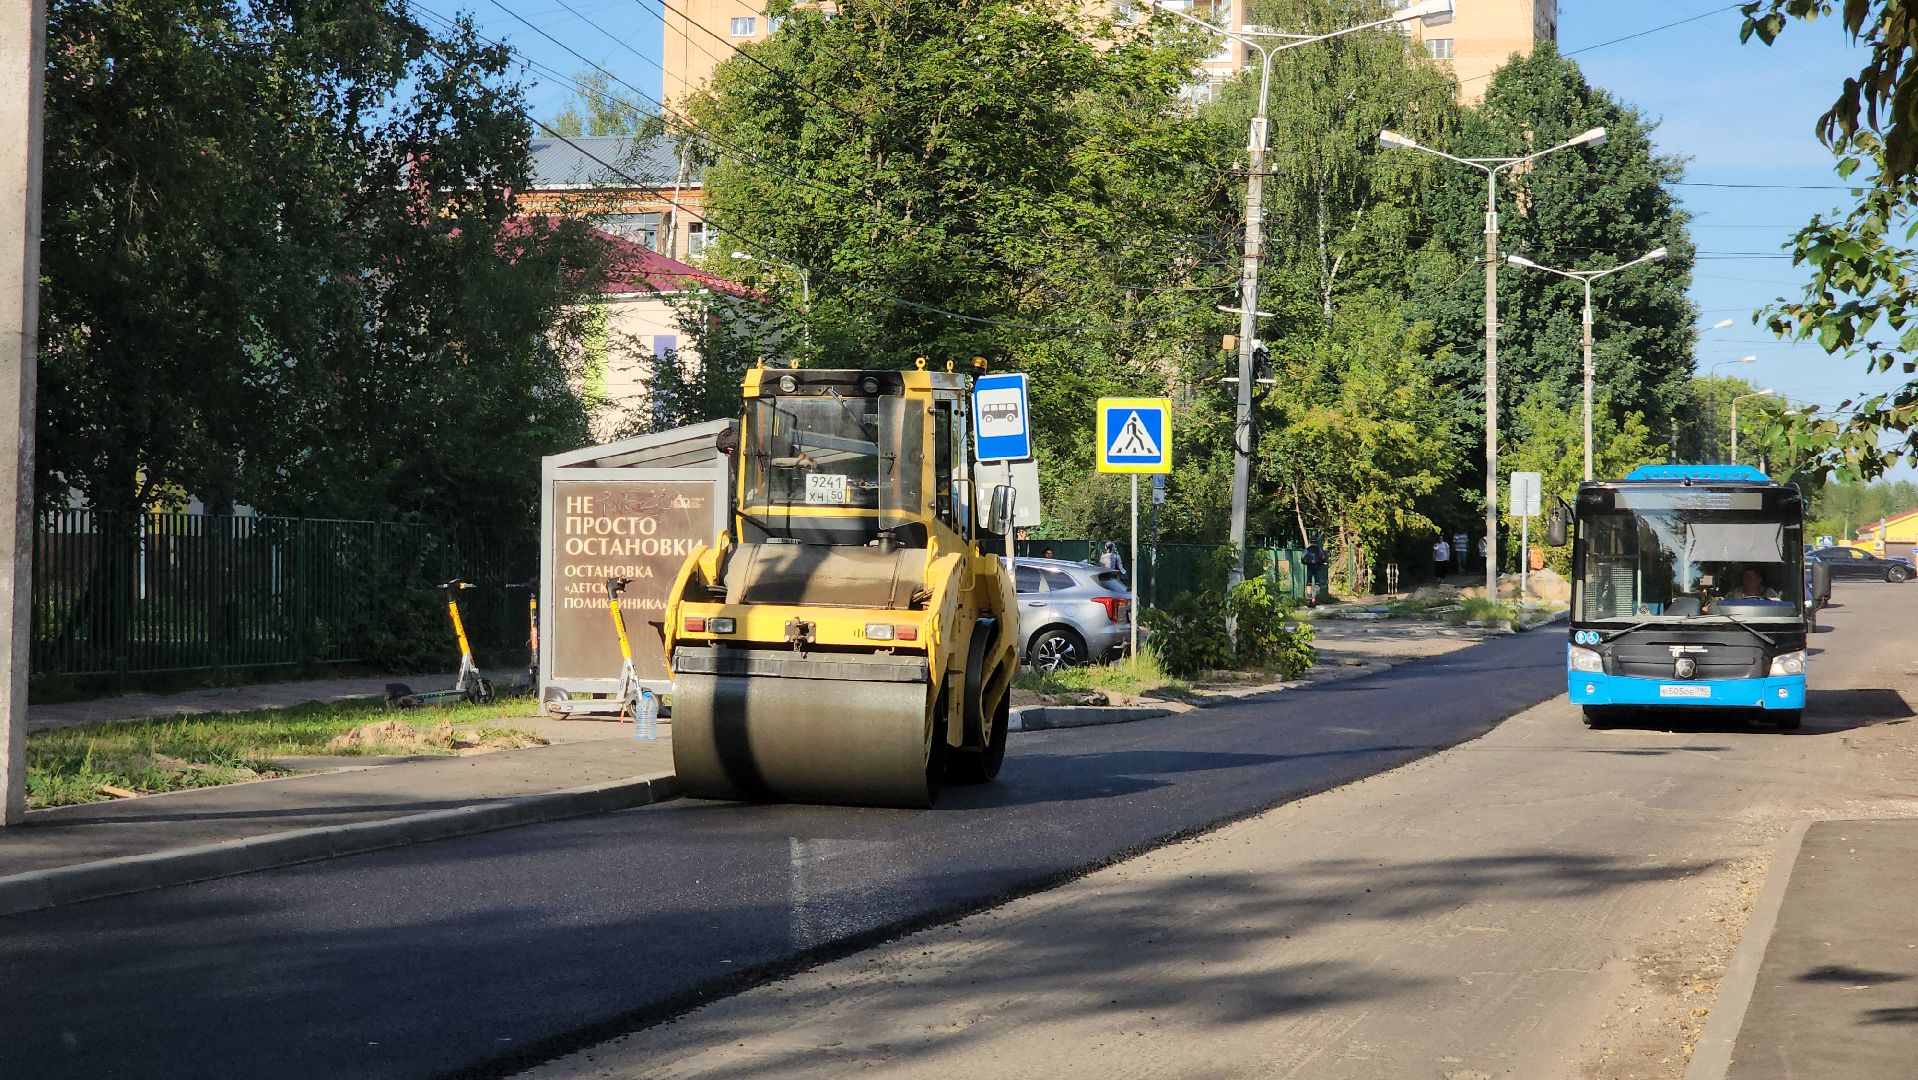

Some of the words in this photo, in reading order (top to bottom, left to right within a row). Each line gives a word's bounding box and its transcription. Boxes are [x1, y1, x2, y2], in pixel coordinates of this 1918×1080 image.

[811, 476, 842, 488] 9241
[831, 490, 843, 500] 50
[566, 496, 594, 514] НЕ
[565, 516, 658, 535] ПРОСТО
[564, 565, 654, 578] ОСТАНОВКА
[564, 582, 624, 594] «ДЕТСК
[564, 597, 668, 610] ПОЛИКИНИКА»
